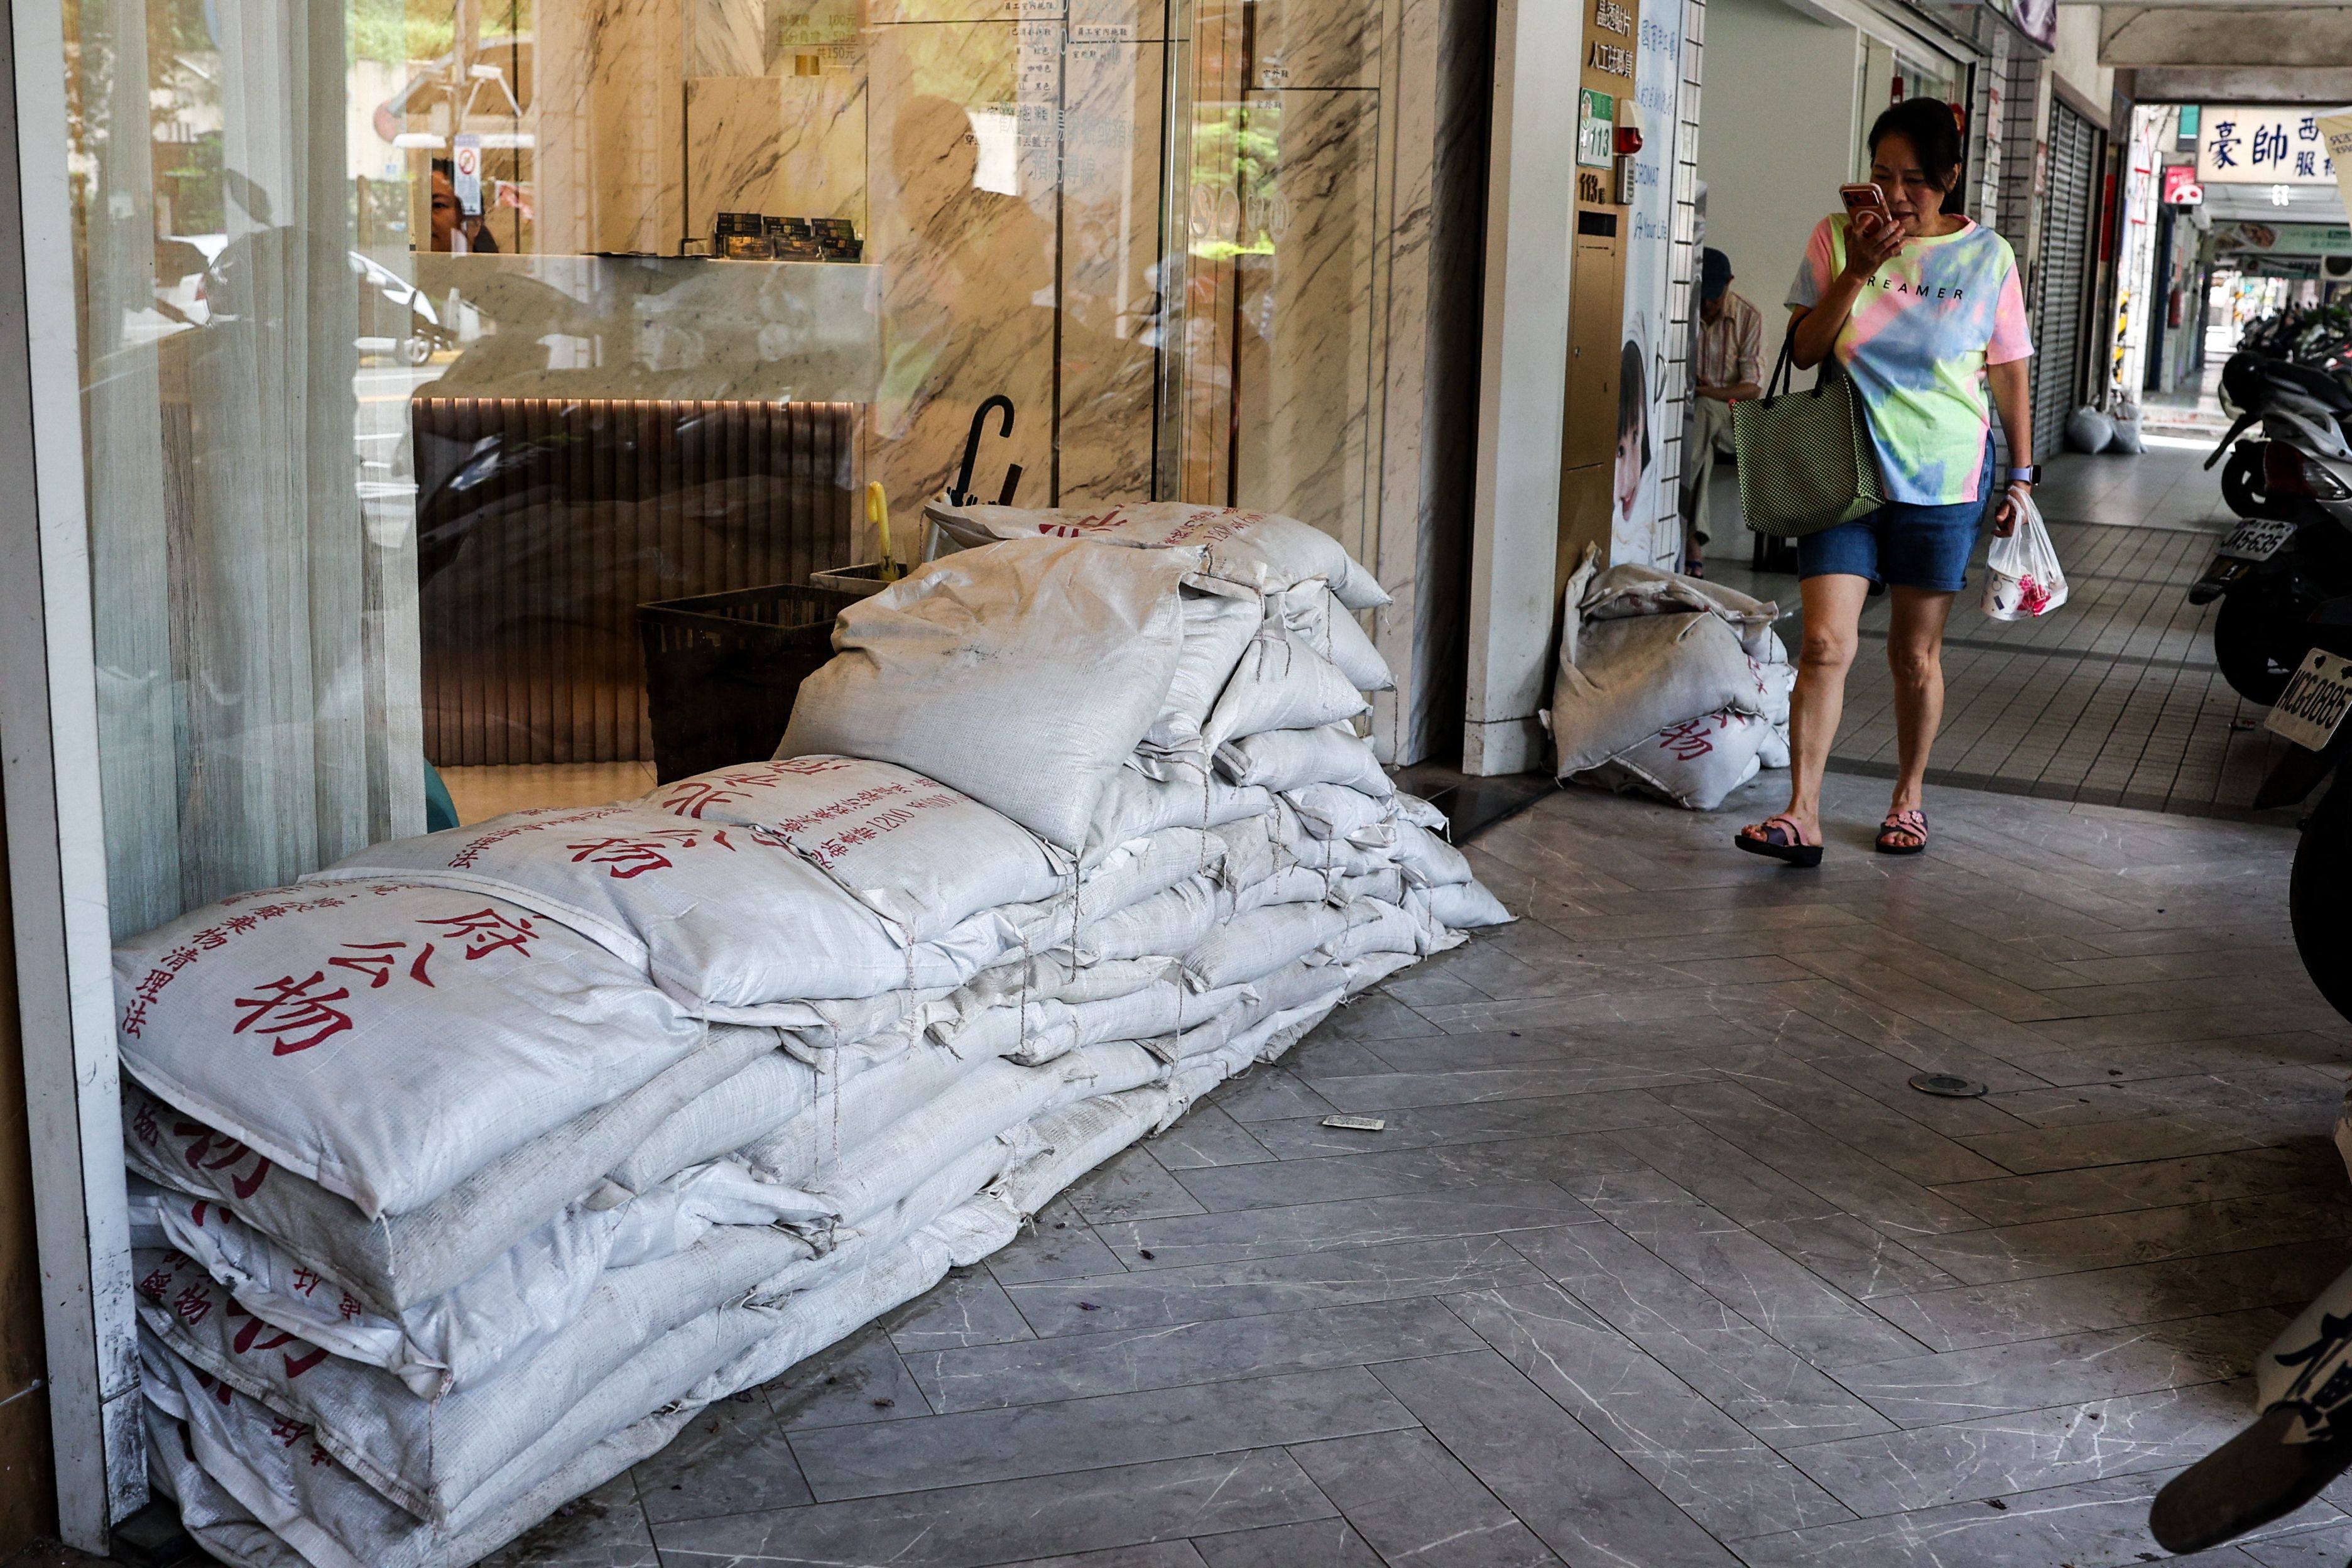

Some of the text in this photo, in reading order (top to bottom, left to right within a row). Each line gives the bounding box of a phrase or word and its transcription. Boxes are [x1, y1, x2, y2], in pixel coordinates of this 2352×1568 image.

[1591, 126, 1609, 157] 113
[2208, 121, 2289, 171] 豪帥
[2294, 117, 2320, 177] 西服
[233, 908, 539, 1056] 府公物
